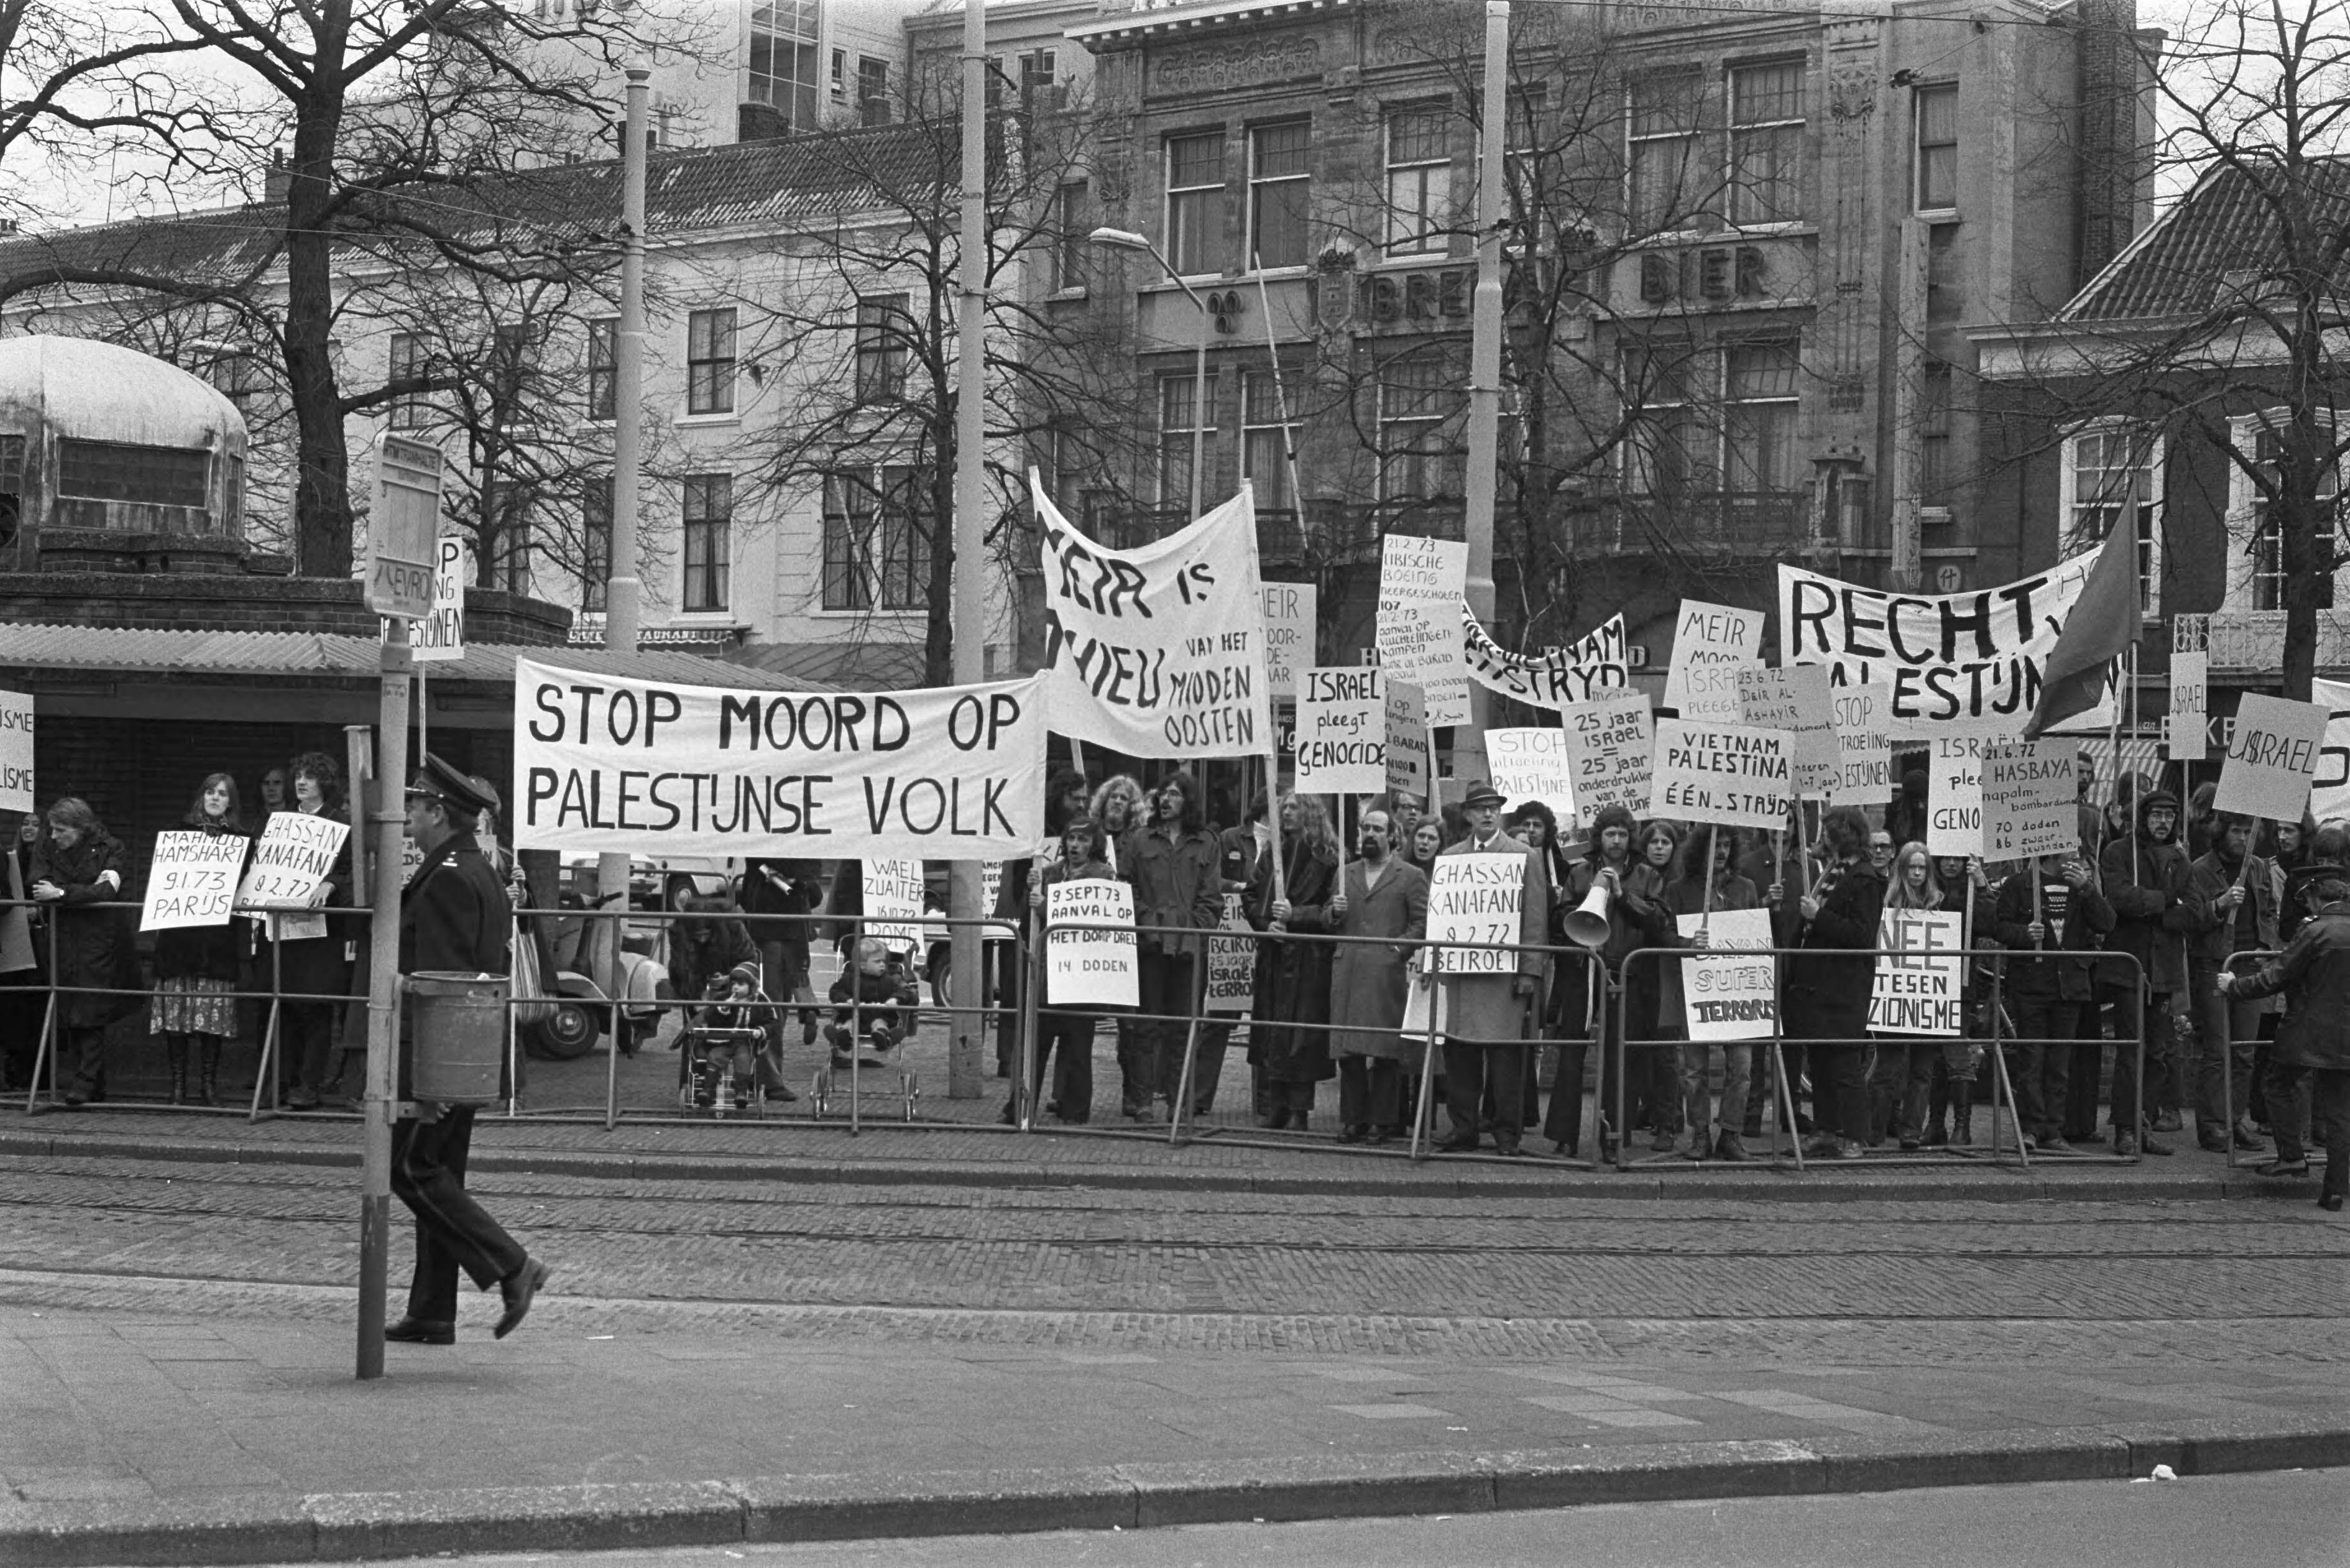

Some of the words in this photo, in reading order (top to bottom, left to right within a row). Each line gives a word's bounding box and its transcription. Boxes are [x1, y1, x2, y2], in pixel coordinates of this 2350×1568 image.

[1383, 569, 1437, 585] BOEING
[1380, 601, 1400, 611] 107
[1683, 611, 1743, 646] MEÏR
[1793, 576, 2048, 665] RECHT
[1221, 631, 1248, 651] HET
[1306, 670, 1381, 702] ISRAEL
[529, 683, 681, 748] STOP
[718, 695, 911, 752] MOORD
[948, 693, 1020, 751] OP
[1574, 712, 1600, 732] 25
[1607, 710, 1643, 729] jaar
[1835, 696, 1873, 727] STOP
[1164, 707, 1254, 748] OOSTEN
[1683, 732, 1780, 755] VIETNAM
[1985, 744, 2036, 760] 21.6.72
[1298, 738, 1386, 776] GENOCIDE
[1582, 757, 1606, 775] 25
[1615, 755, 1648, 774] jaar
[1994, 758, 2072, 783] HASBAYA
[527, 767, 833, 835] PALESTIJNSE
[863, 776, 1016, 837] VOLK
[1596, 791, 1616, 802] van
[1623, 786, 1637, 797] de
[263, 818, 343, 852] GHASSAN
[1996, 822, 2012, 833] 70
[1996, 836, 2012, 849] 86
[154, 845, 243, 863] HAMSHARI
[163, 871, 226, 891] 9.1.73
[872, 859, 920, 881] WAEL
[1433, 863, 1524, 885] GHASSAN
[864, 877, 924, 903] ZUAITER
[1052, 890, 1061, 903] 9
[1066, 886, 1101, 901] SEPT
[1051, 905, 1112, 919] AANVAL
[1118, 907, 1133, 919] OP
[1050, 931, 1079, 944] HET
[1876, 920, 1950, 971] NEE
[1058, 960, 1072, 972] 14
[1083, 960, 1128, 972] DODEN
[1428, 951, 1517, 972] BEIROET
[1694, 966, 1775, 992] SUPER
